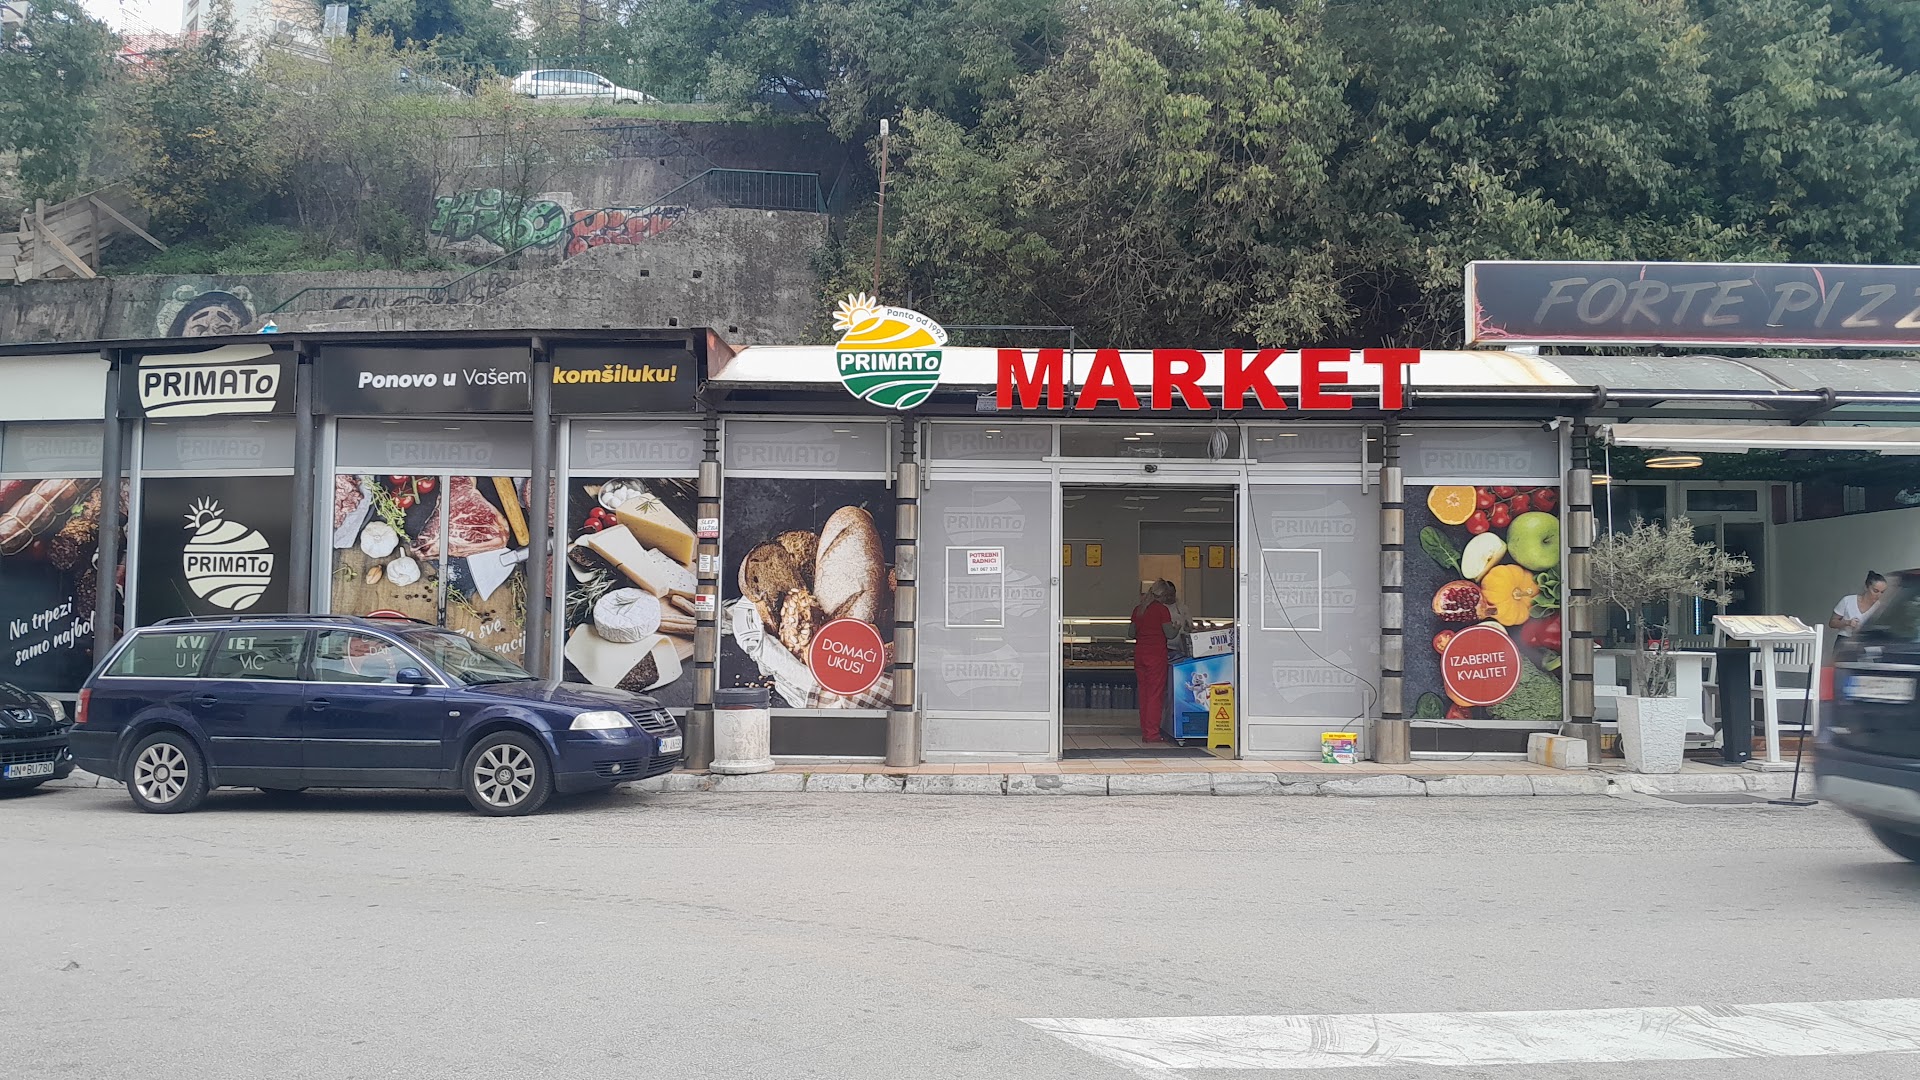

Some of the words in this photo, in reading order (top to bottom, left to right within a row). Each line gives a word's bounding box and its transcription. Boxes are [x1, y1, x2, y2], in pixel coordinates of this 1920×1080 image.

[1534, 277, 1754, 326] FORTE
[887, 309, 914, 320] Panto
[916, 317, 929, 326] od
[929, 323, 945, 342] 1992.
[841, 353, 939, 371] PRIMATo
[144, 368, 273, 397] PRIMATo
[358, 371, 437, 389] Ponovo
[442, 371, 457, 387] u
[463, 368, 527, 385] Vašem
[553, 364, 677, 384] komšiluku!
[997, 348, 1421, 410] MARKET
[187, 556, 269, 573] PRIMATo
[1250, 572, 1307, 581] KALITET
[10, 619, 29, 640] Na
[32, 596, 72, 631] trpezi
[479, 619, 502, 639] sve
[15, 640, 50, 666] samo
[53, 610, 96, 649] najbol
[821, 638, 877, 663] DOMAĆI
[1450, 652, 1506, 667] IZABERITE
[827, 655, 866, 675] UKUSI
[1456, 666, 1508, 681] KVALITET
[10, 765, 22, 776] HN
[27, 762, 53, 774] BU780
